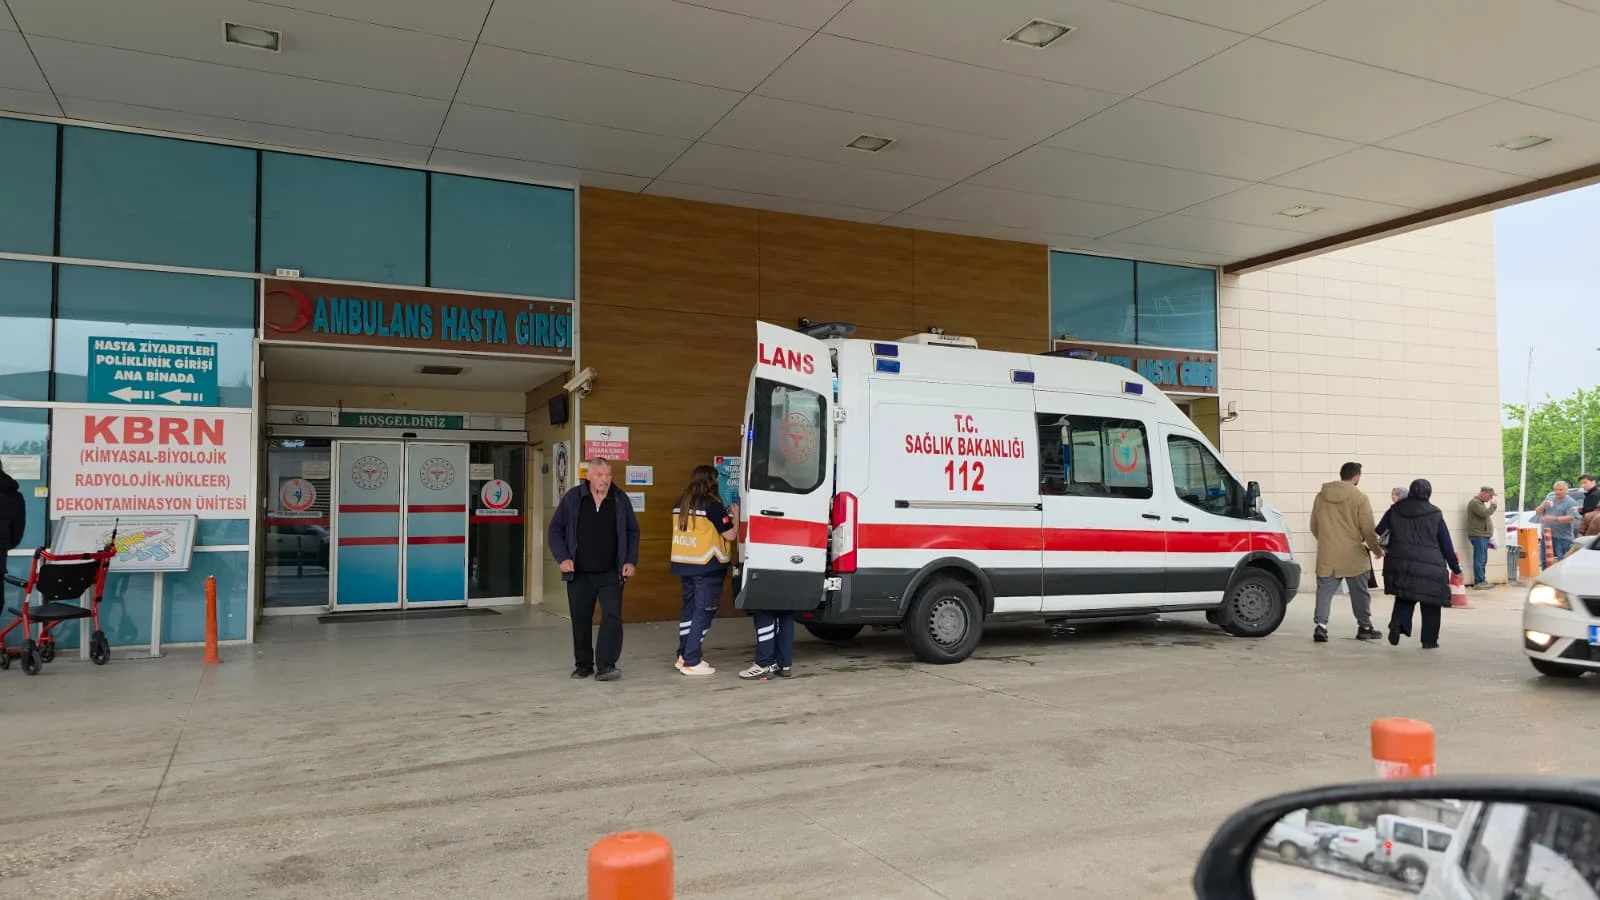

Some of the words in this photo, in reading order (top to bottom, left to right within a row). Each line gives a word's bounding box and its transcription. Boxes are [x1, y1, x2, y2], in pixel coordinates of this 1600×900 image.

[312, 296, 434, 340] AMBULANS
[441, 305, 508, 345] HASTA
[515, 303, 573, 353] GİRİŞİ
[95, 340, 136, 352] HASTA
[139, 341, 215, 356] ZİYARETLERİ
[96, 353, 171, 369] POLİKLİNİK
[174, 356, 213, 373] GİRİŞİ
[759, 342, 815, 375] LANS
[114, 370, 142, 381] ANA
[146, 369, 195, 383] BİNADA
[84, 415, 224, 446] KBRN
[954, 413, 978, 434] T.C.
[905, 432, 954, 455] SAĞLIK
[958, 437, 1025, 459] BAKANLIĞI
[80, 447, 227, 465] (KİMYASAL-BİYOLOJİK
[75, 471, 231, 490] RADYOLOJİK-NÜKLEER)
[944, 460, 984, 491] 112
[56, 495, 191, 511] DEKONTAMİNASYON
[196, 494, 247, 511] ÜNİTESİ
